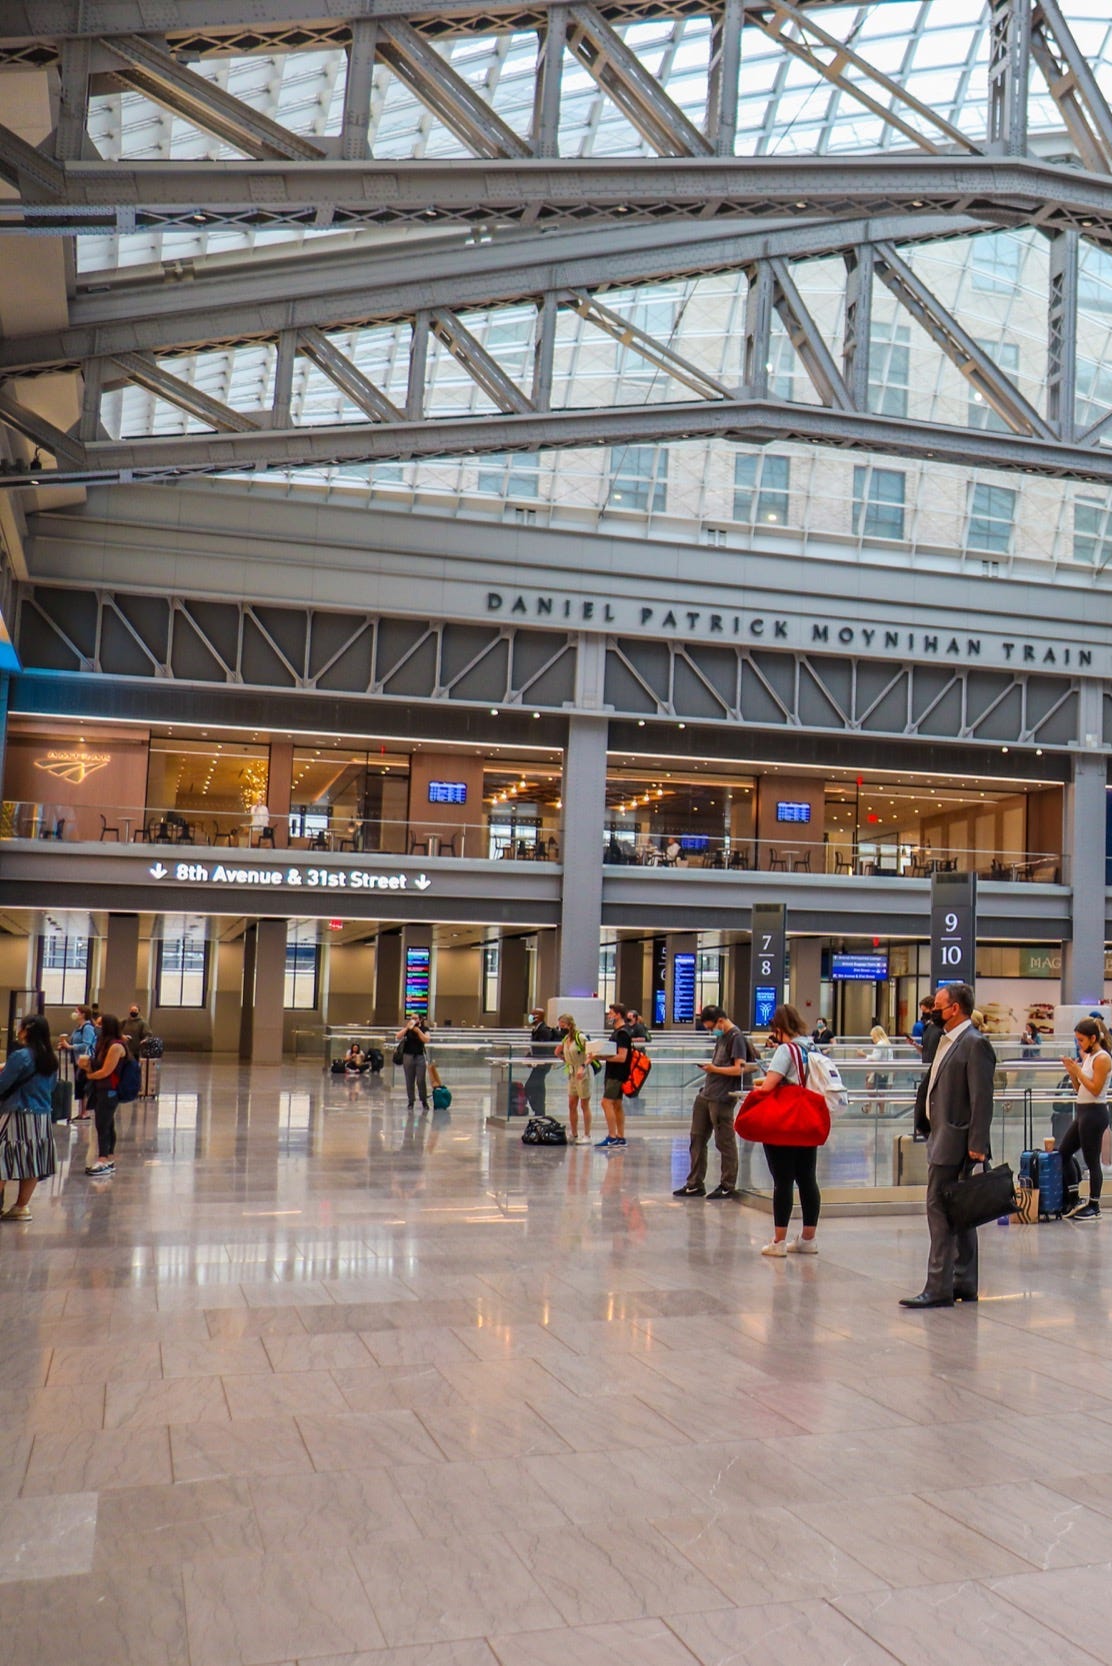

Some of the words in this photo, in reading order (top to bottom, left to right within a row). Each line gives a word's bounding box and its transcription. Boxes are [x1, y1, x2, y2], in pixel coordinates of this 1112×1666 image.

[487, 592, 616, 623] DANIEL
[641, 607, 789, 639] PATRICK
[812, 624, 982, 656] MOYNIHAN
[1003, 643, 1092, 667] TRAIN
[176, 864, 207, 882] 8th
[213, 865, 283, 885] Avenue
[287, 868, 303, 886] &
[307, 870, 347, 888] 31st
[351, 870, 407, 890] Street
[945, 912, 958, 933] 9
[762, 935, 772, 950] 7
[941, 946, 962, 966] 10
[761, 960, 772, 976] 8
